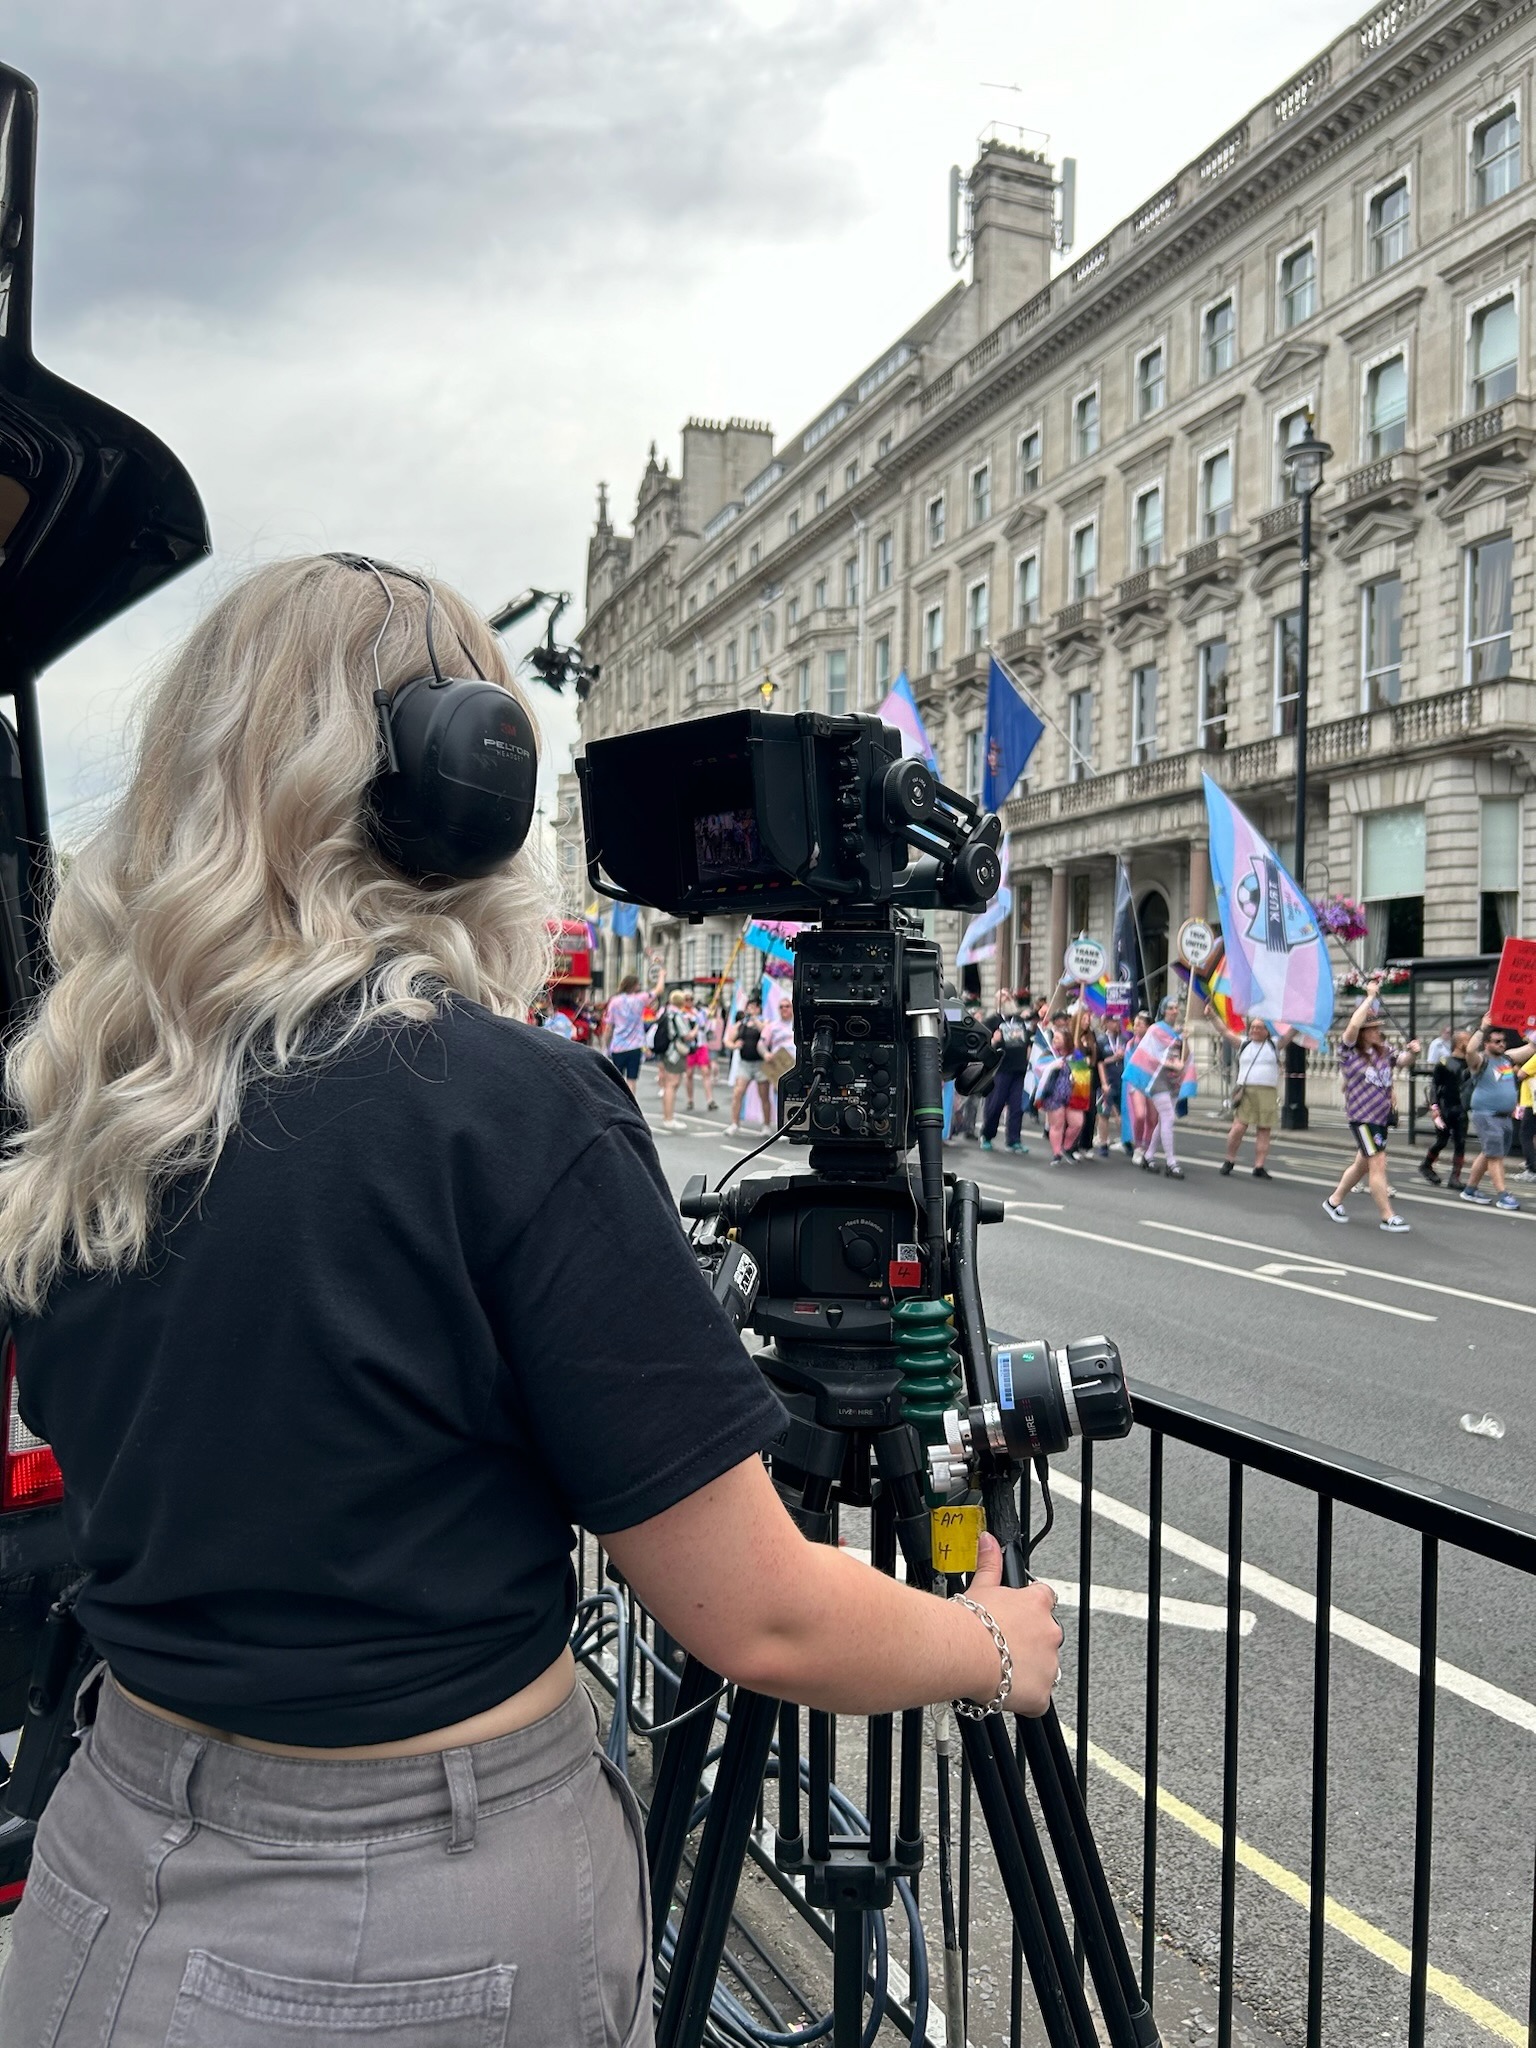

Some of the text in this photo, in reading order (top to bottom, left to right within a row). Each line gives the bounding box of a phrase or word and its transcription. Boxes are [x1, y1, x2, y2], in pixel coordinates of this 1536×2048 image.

[484, 738, 530, 759] PELTOR
[860, 1218, 884, 1233] Balance
[897, 1266, 911, 1278] 4
[1025, 1414, 1038, 1437] HIRE
[938, 1541, 952, 1560] 4
